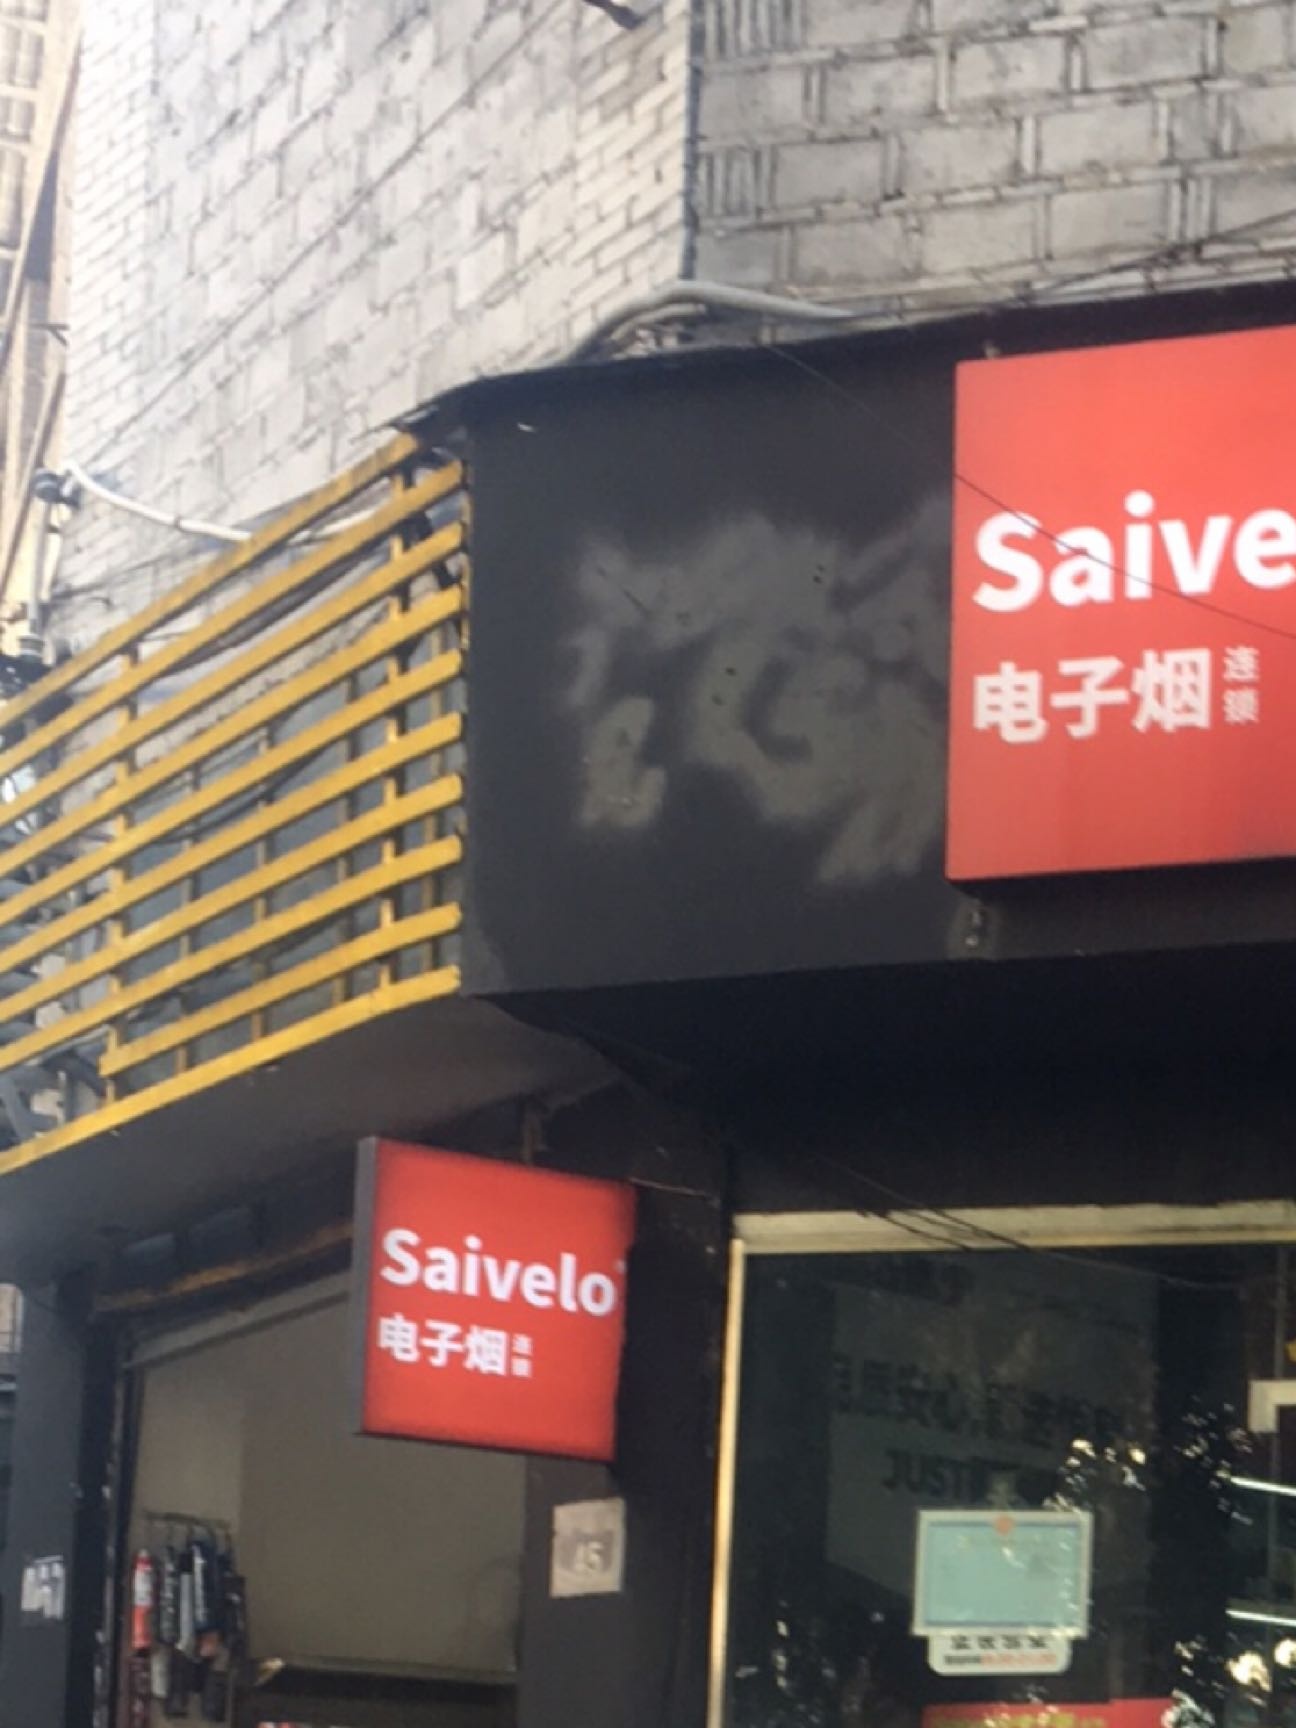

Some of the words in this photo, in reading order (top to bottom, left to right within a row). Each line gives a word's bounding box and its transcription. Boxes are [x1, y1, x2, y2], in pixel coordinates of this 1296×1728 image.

[972, 648, 1211, 745] 电子烟
[1223, 645, 1260, 726] 连锁
[380, 1227, 617, 1317] Saivelo
[377, 1313, 507, 1377] 电子烟
